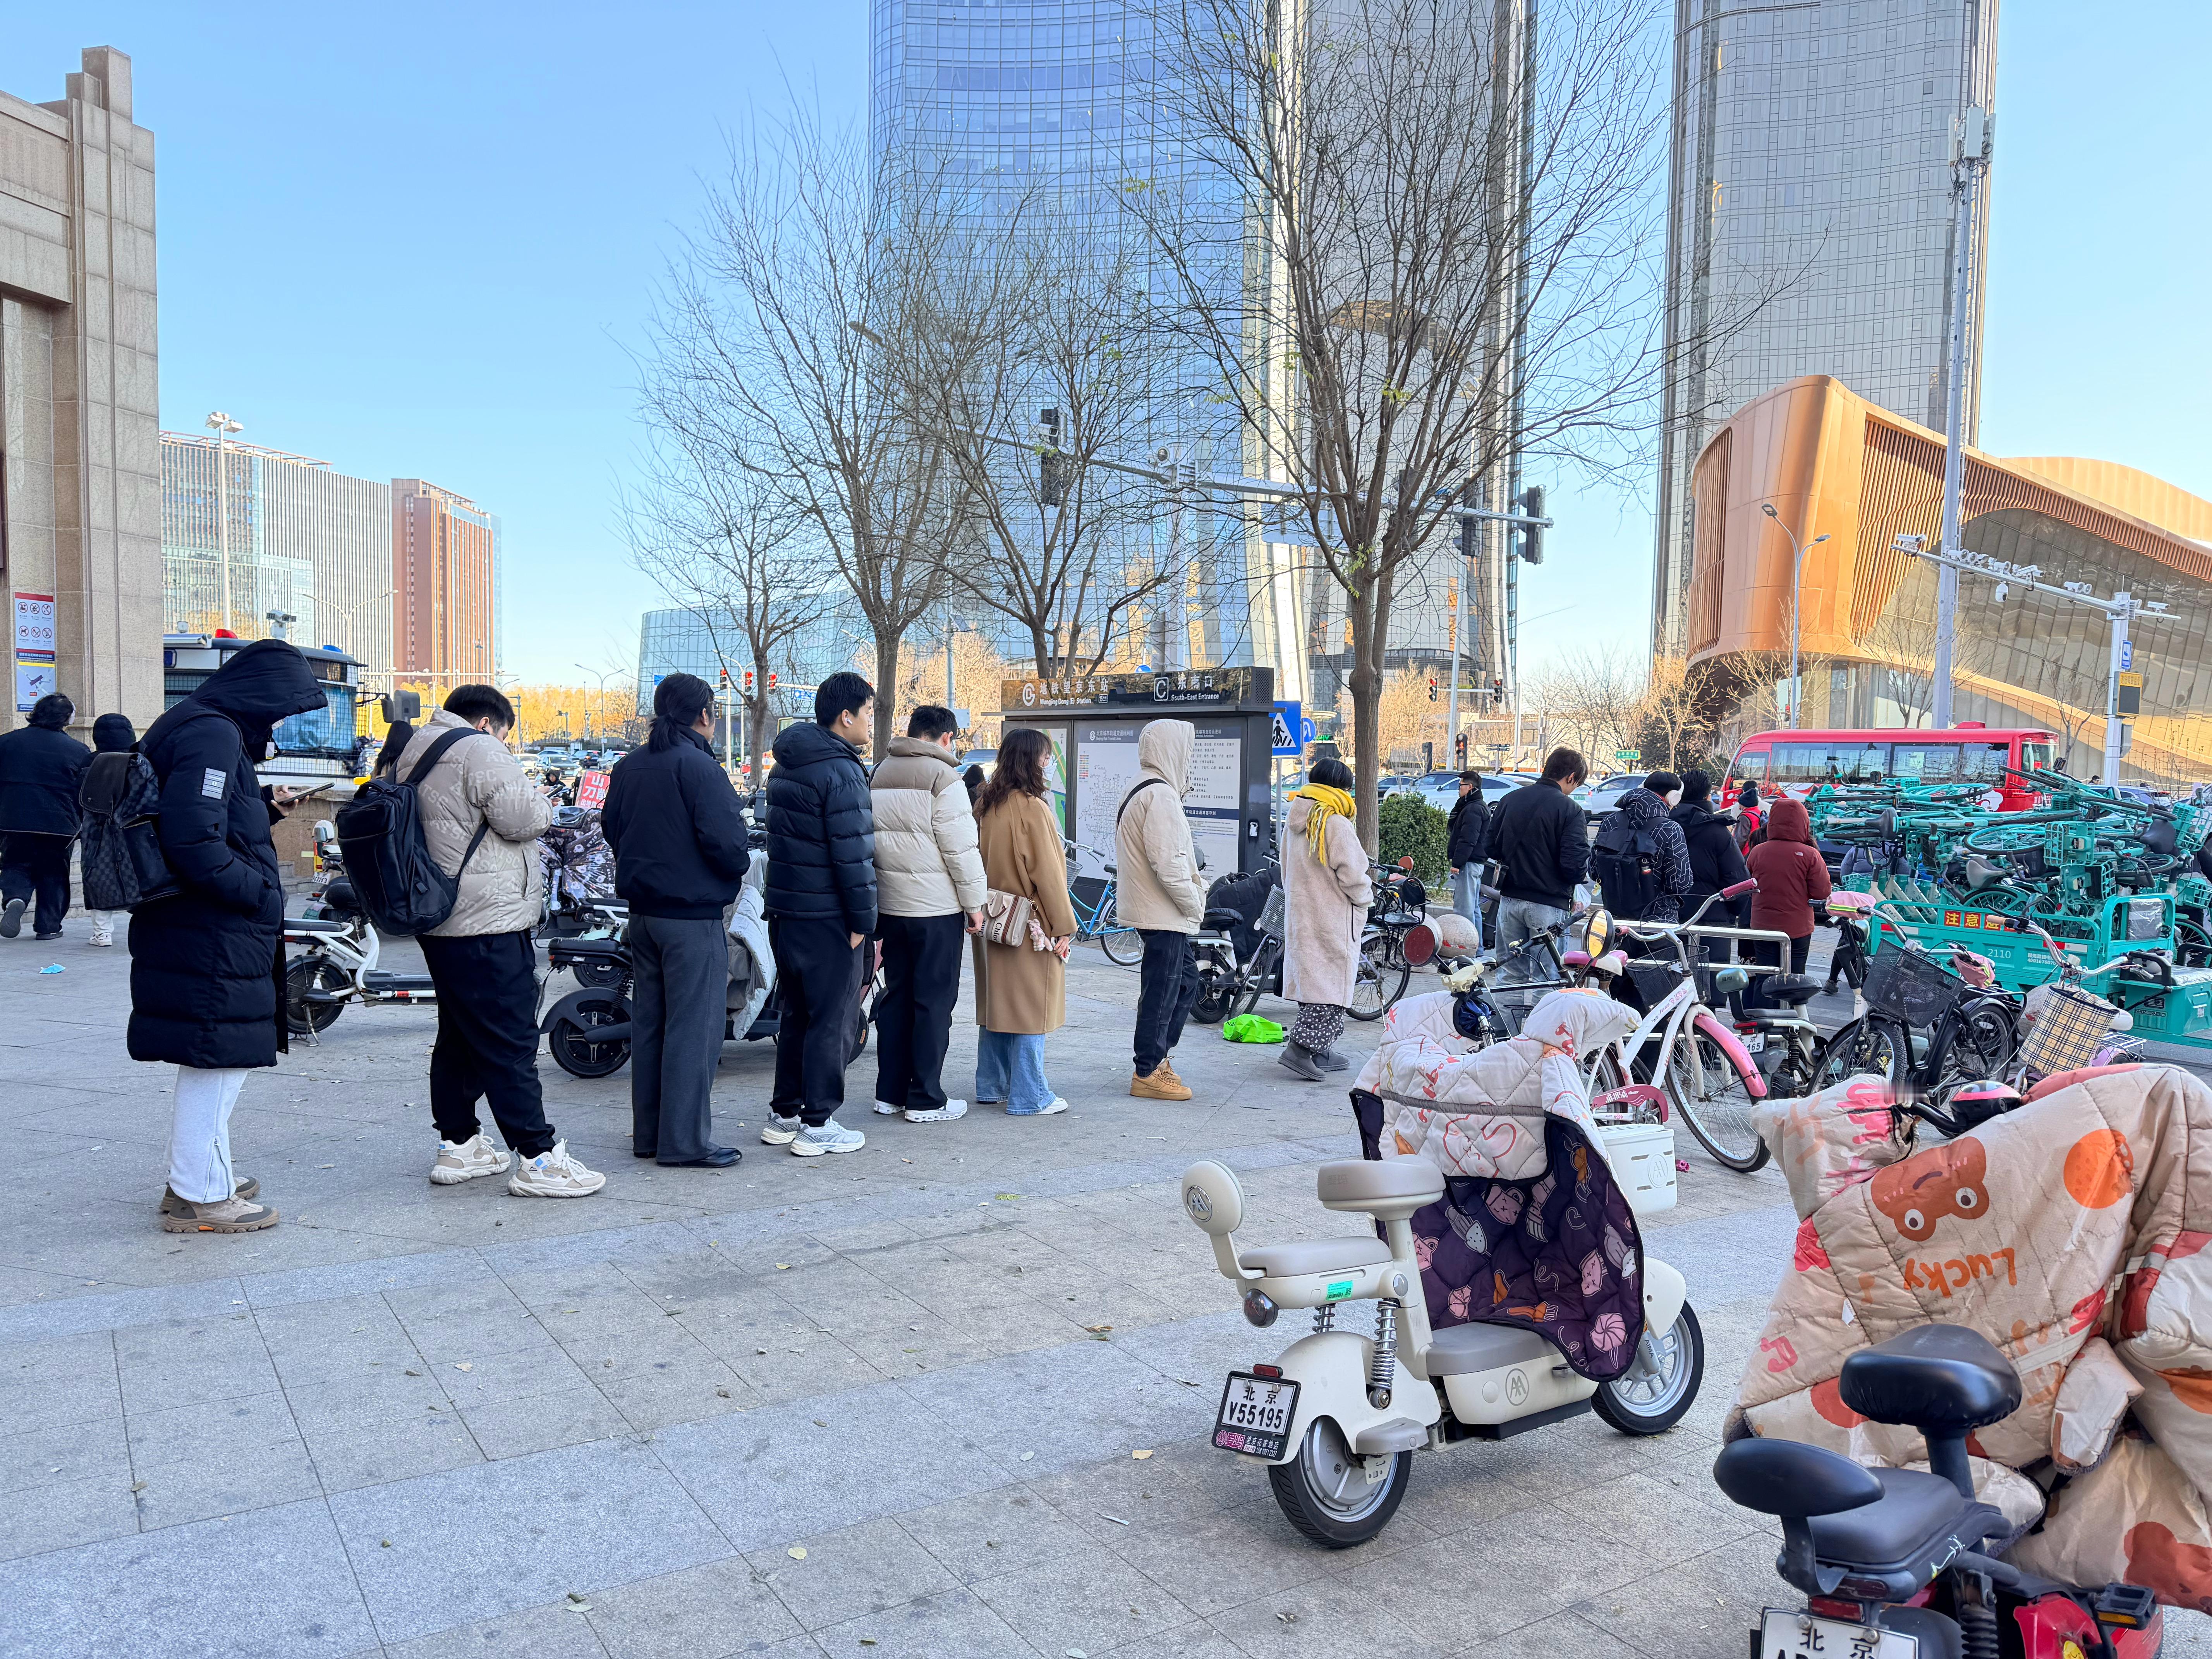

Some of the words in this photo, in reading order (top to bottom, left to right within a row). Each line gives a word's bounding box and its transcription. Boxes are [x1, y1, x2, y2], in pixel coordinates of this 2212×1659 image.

[1039, 678, 1108, 695] 地铁望京东站
[1178, 672, 1212, 690] 东南口
[1987, 949, 2011, 958] 2110
[1747, 1042, 1761, 1052] 165
[1902, 1247, 2018, 1298] Lucky
[1645, 1340, 1654, 1358] AIMA
[1243, 1387, 1279, 1404] 北京
[1800, 1628, 1875, 1659] 北京
